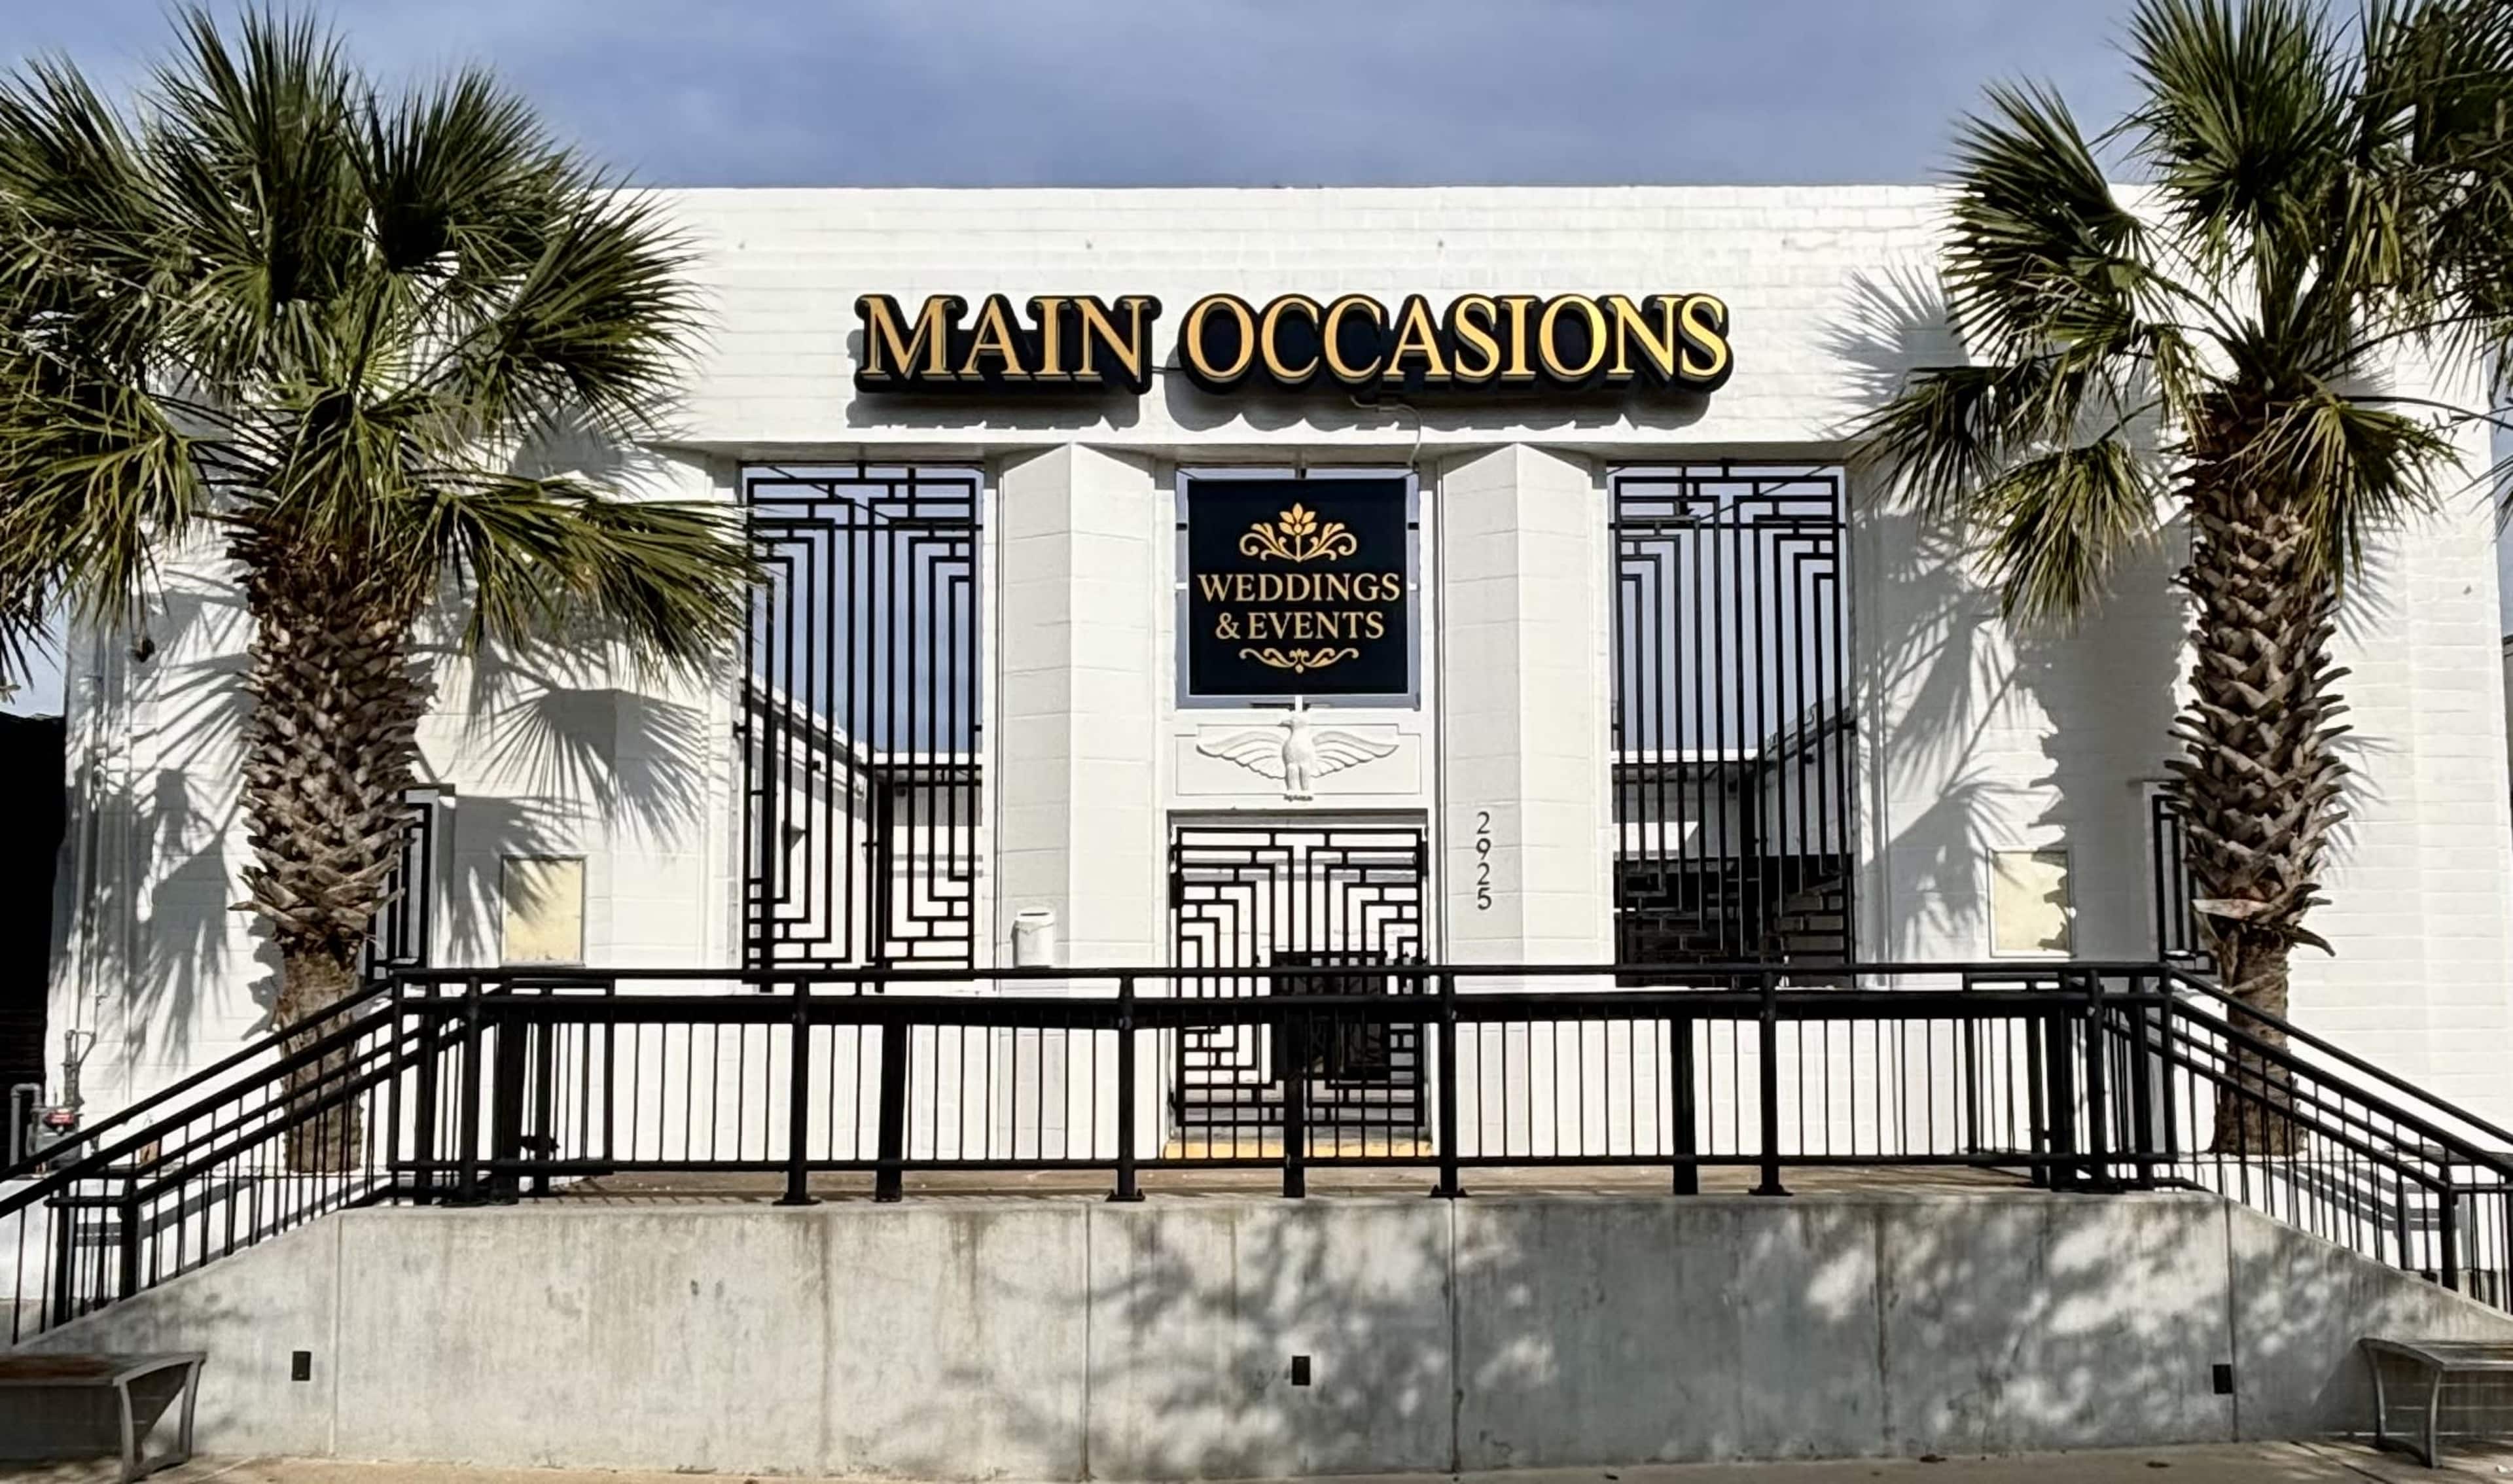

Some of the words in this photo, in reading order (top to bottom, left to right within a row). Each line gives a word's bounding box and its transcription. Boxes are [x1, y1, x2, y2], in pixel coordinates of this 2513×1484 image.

[860, 295, 1150, 381] MAIN
[1186, 295, 1729, 383] OCCASIONS
[1197, 573, 1400, 601] WEDDINGS
[1215, 612, 1241, 639] &
[1248, 611, 1385, 639] EVENTS
[1475, 811, 1493, 910] 2925
